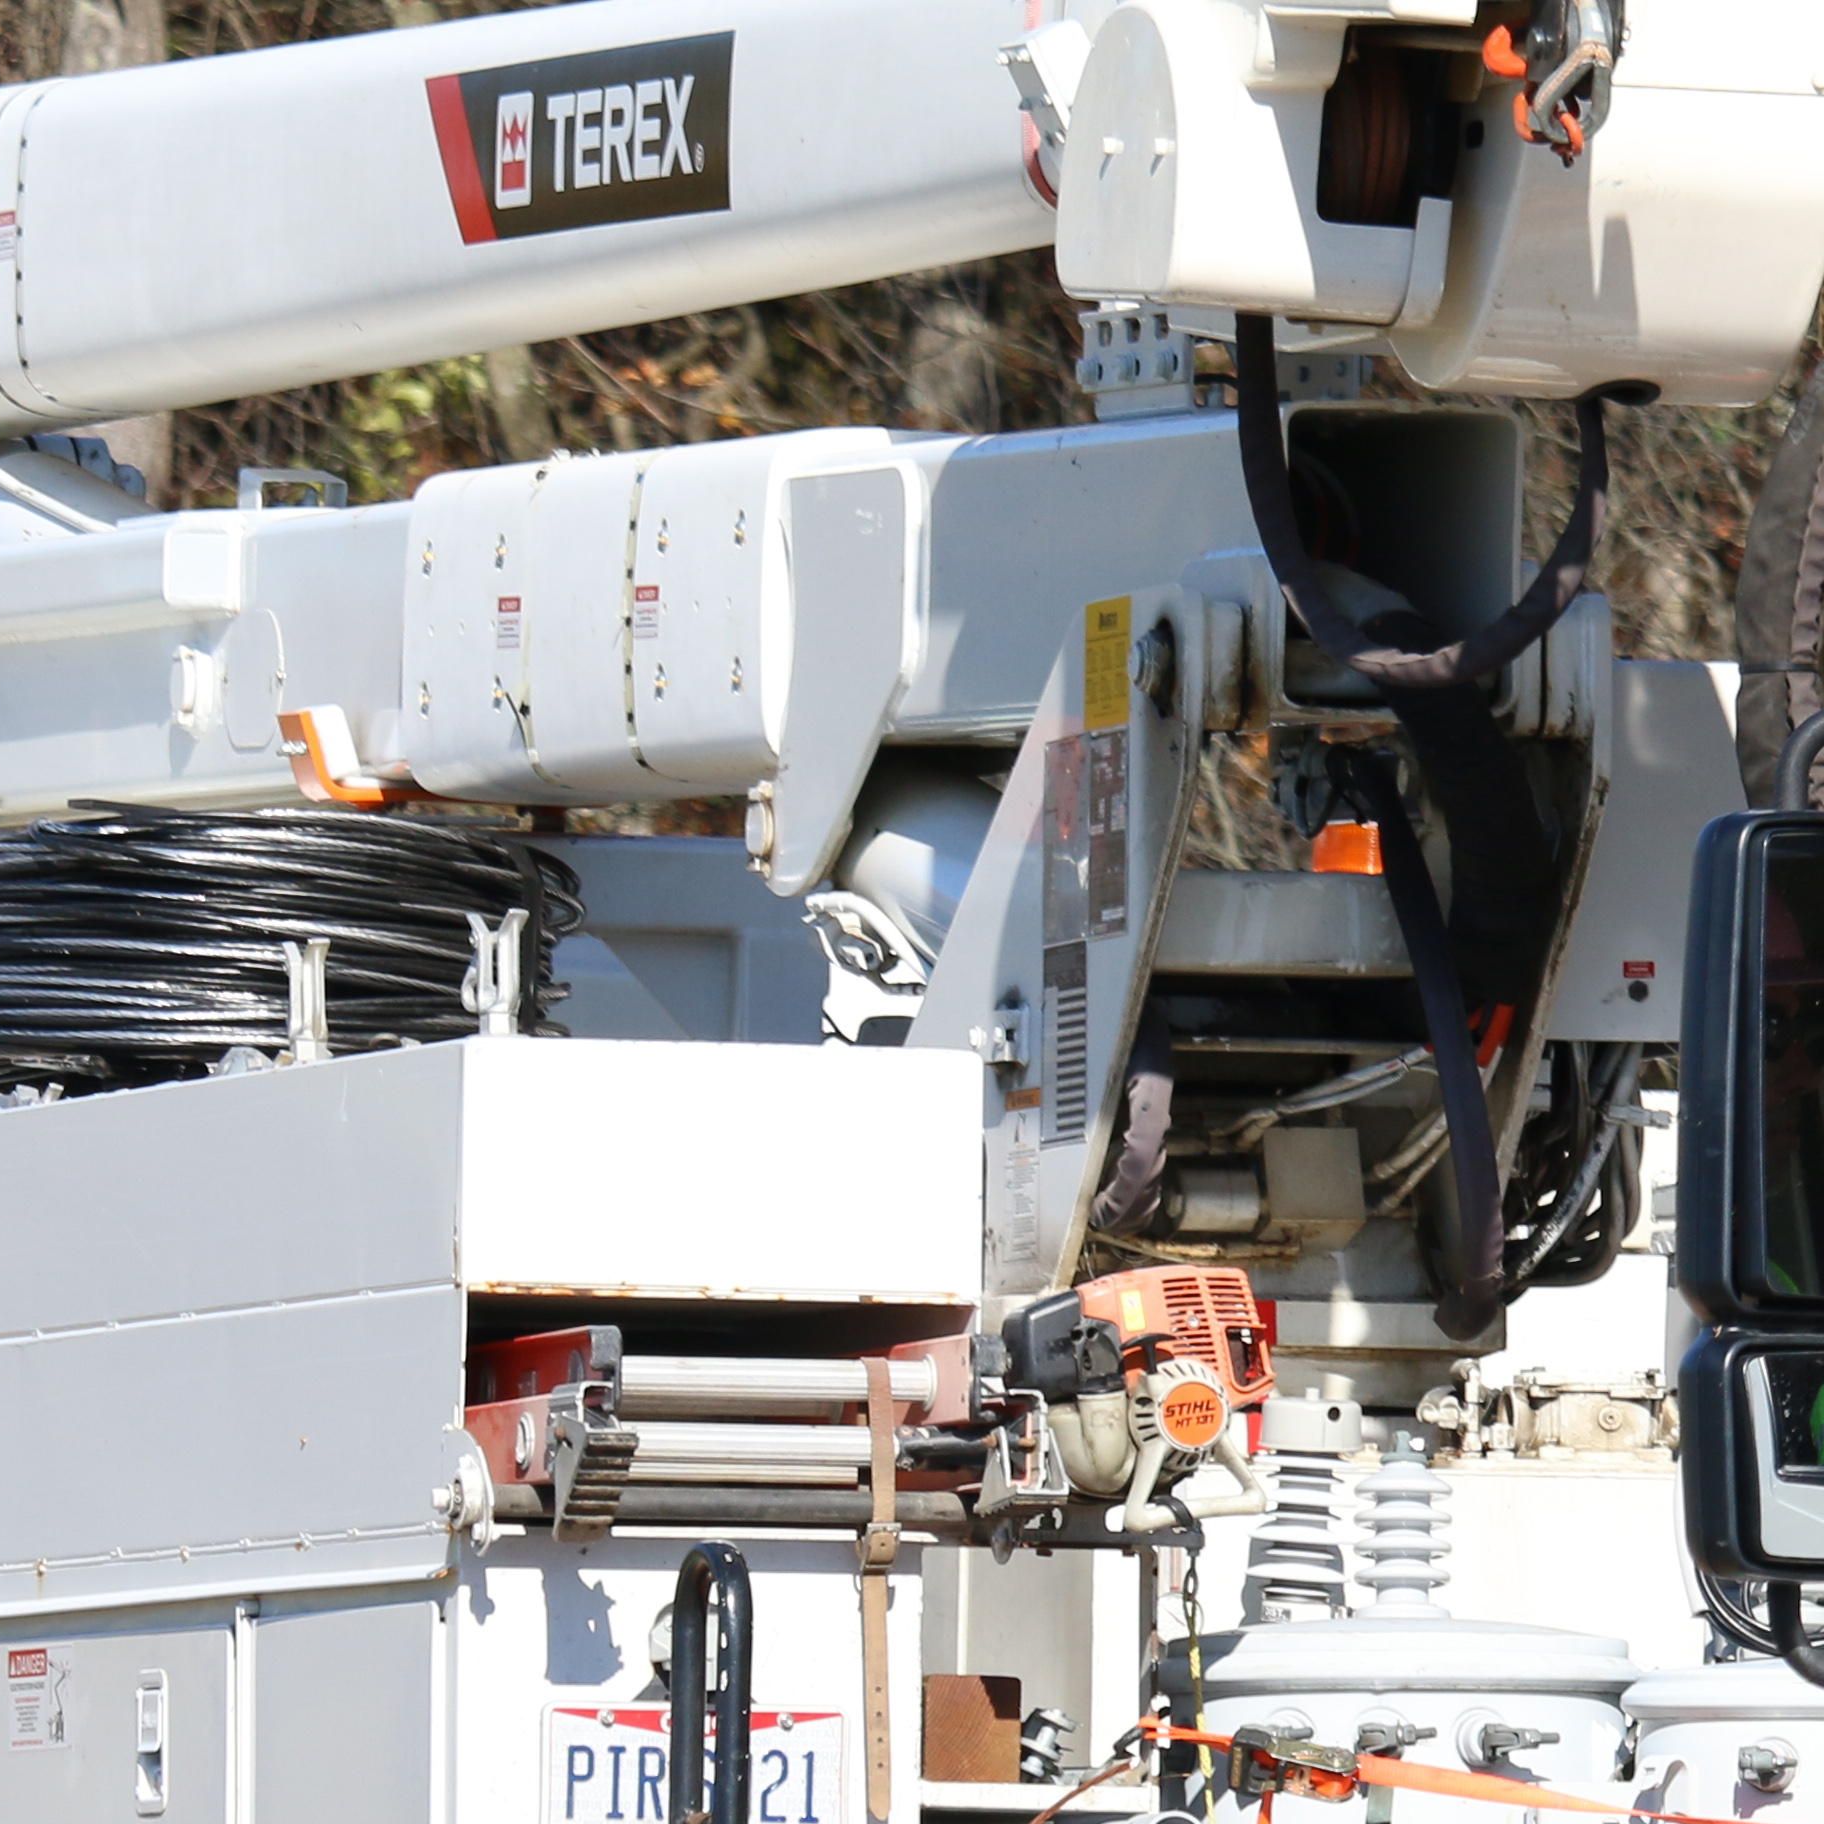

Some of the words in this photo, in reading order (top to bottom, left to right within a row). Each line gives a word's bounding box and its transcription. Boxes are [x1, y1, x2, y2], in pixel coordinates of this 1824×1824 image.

[546, 74, 696, 194] TEREX
[1164, 1399, 1216, 1418] STIHL
[1175, 1416, 1193, 1428] HT
